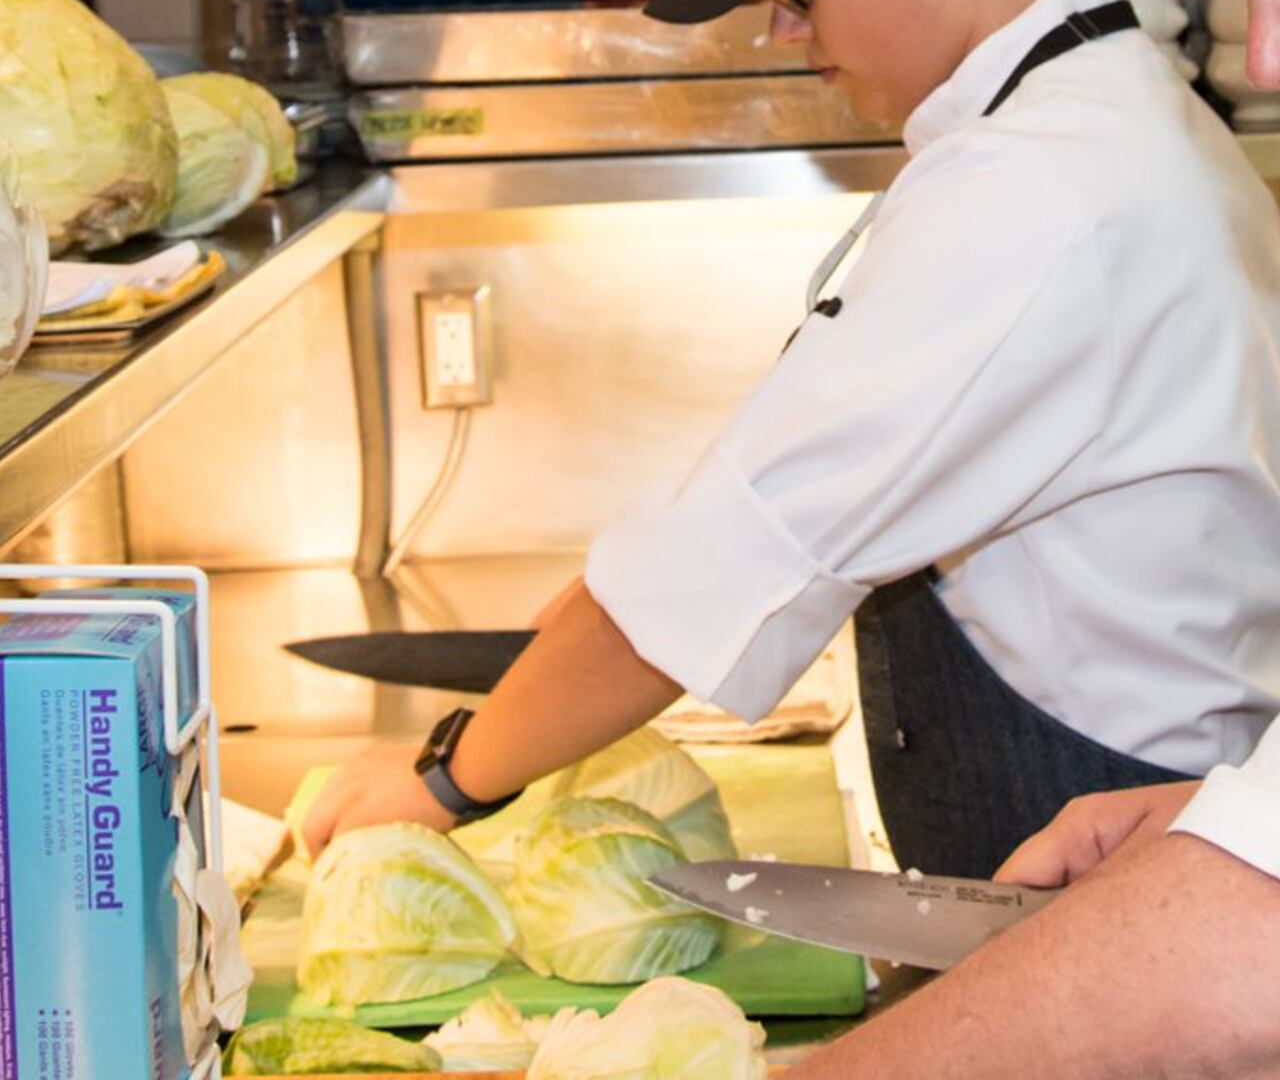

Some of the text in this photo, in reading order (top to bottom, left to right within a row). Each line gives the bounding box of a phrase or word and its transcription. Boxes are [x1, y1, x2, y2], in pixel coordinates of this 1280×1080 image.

[68, 688, 86, 913] POWDER FREE LATEX GLOVES
[84, 689, 123, 909] Handy Guard
